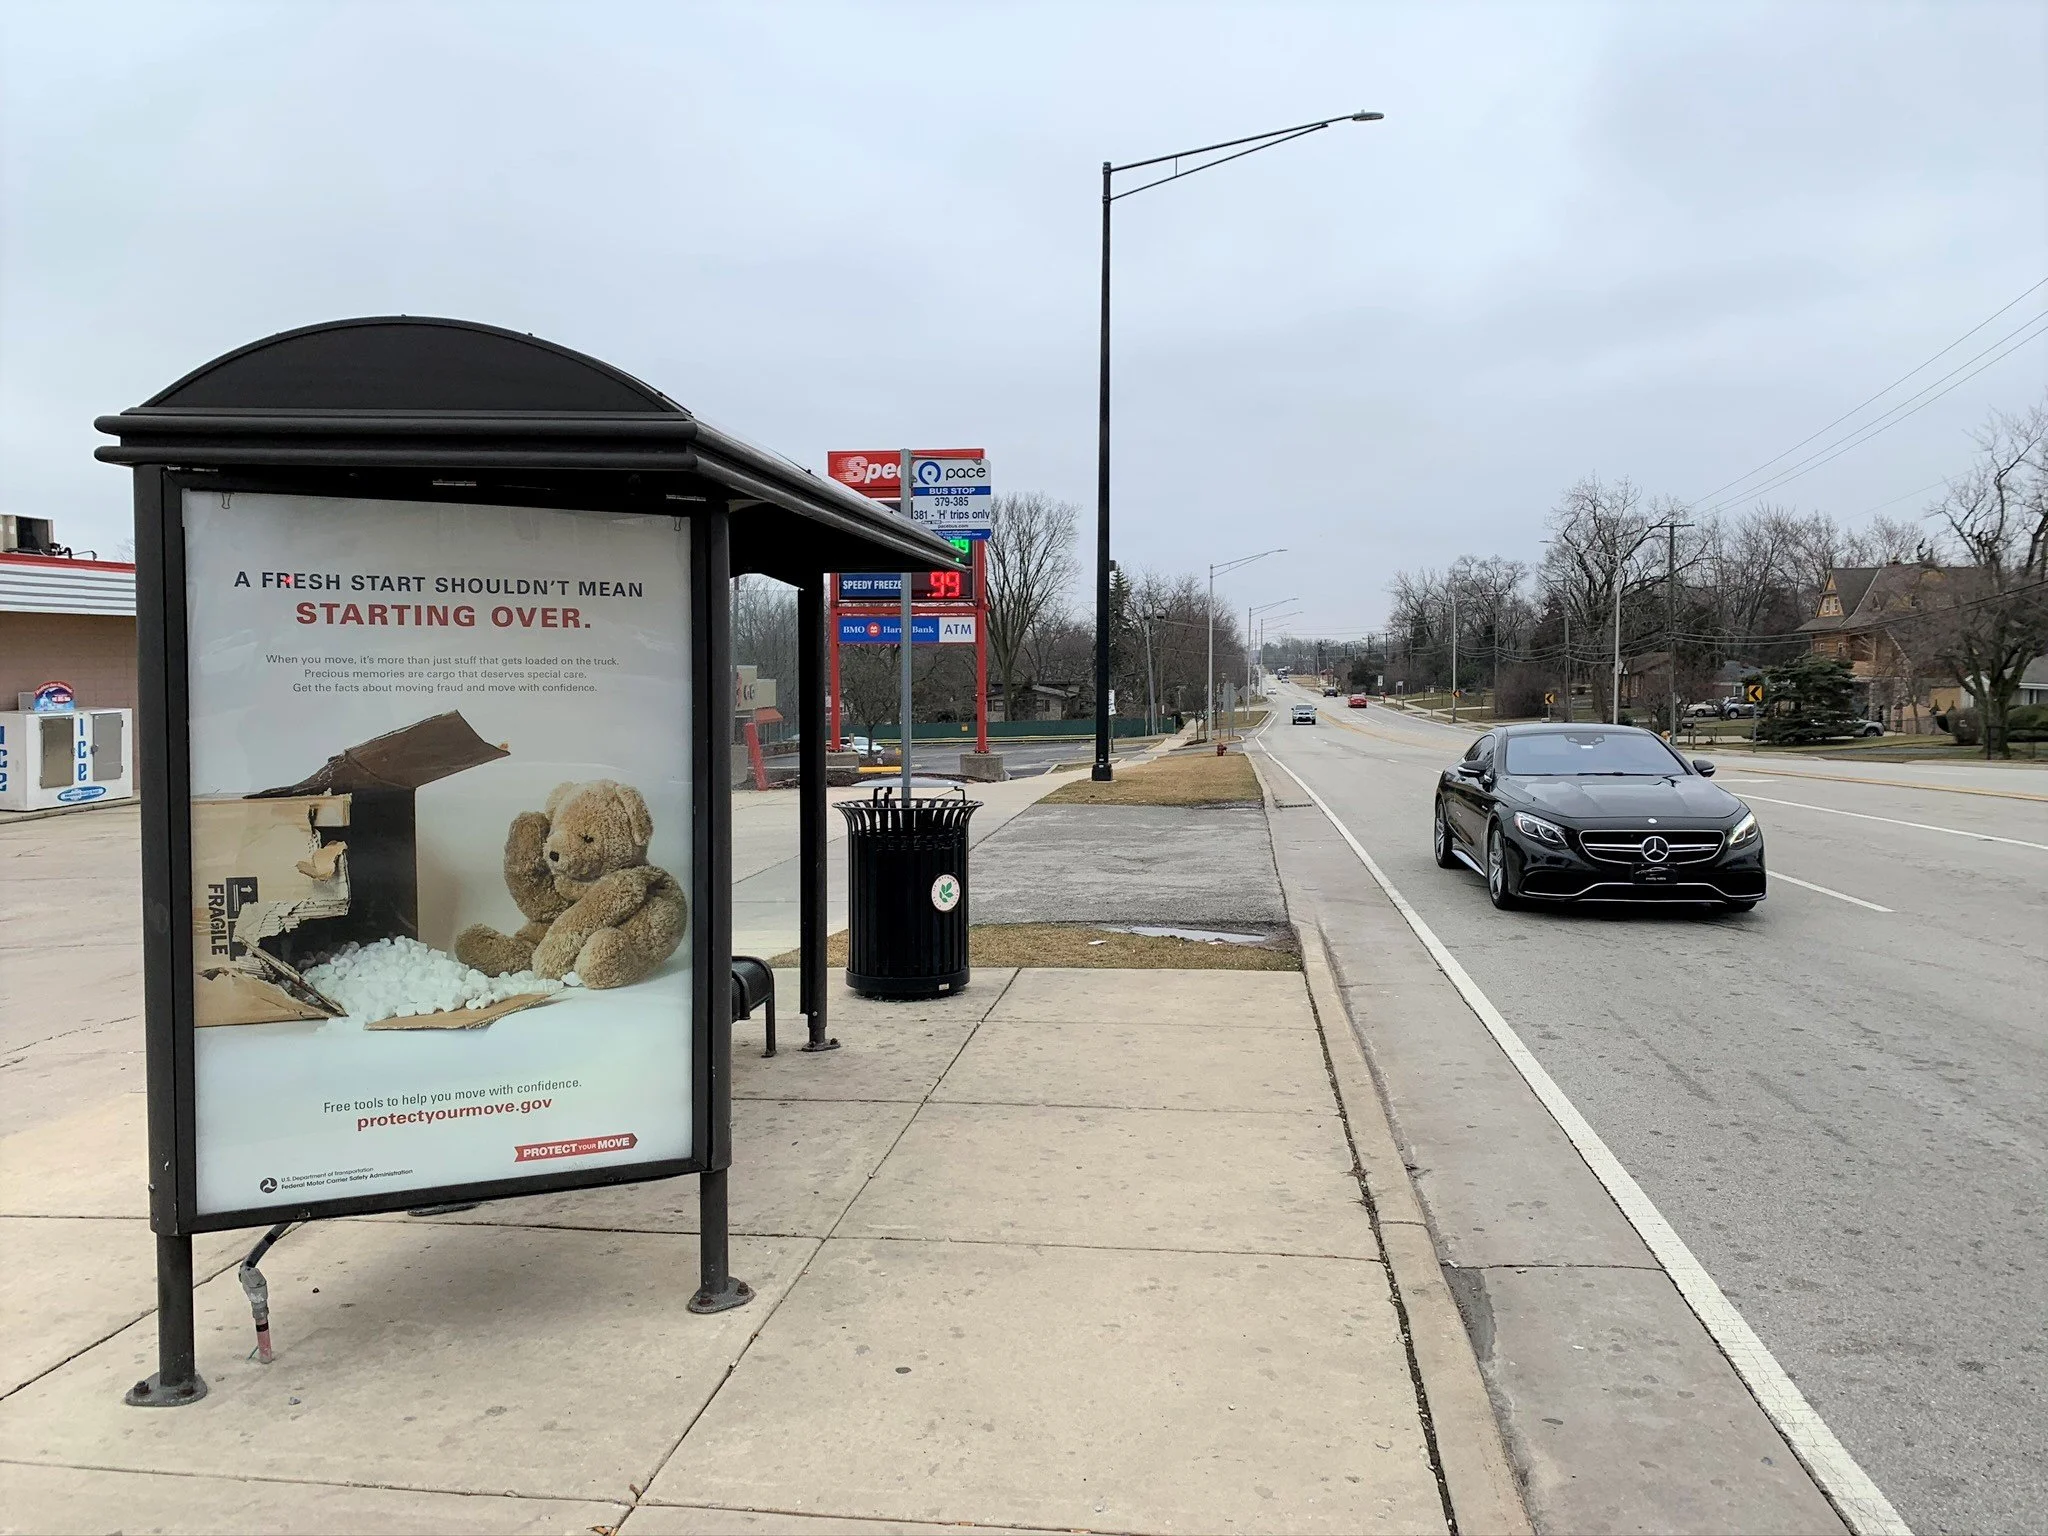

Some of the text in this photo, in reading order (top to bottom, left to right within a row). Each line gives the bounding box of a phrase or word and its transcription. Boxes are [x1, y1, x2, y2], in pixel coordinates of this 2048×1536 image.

[946, 467, 986, 480] pace
[934, 497, 969, 506] 379-385
[914, 510, 928, 520] 381
[950, 510, 970, 520] trips
[972, 509, 990, 520] only
[234, 572, 643, 598] A FRESH START SHOULDN'T MEAN
[842, 580, 872, 590] SPEEDY
[296, 602, 591, 629] STARTING OVER.
[843, 626, 865, 634] BMO
[912, 625, 934, 634] Bank
[944, 624, 972, 635] ATM
[266, 654, 298, 664] When
[301, 656, 320, 666] you
[360, 656, 374, 664] it's
[408, 656, 430, 664] than
[433, 656, 452, 666] just
[454, 656, 476, 664] stuff
[479, 656, 498, 665] that
[502, 657, 522, 666] gets
[525, 656, 558, 665] loaded
[576, 657, 592, 666] the
[594, 657, 620, 666] truck.
[304, 669, 350, 678] Precious
[352, 669, 404, 678] memories
[426, 671, 455, 680] cargo
[458, 670, 478, 678] that
[480, 670, 524, 678] deserves
[528, 670, 560, 680] special
[292, 683, 312, 692] Get
[314, 684, 332, 692] the
[334, 684, 360, 692] facts
[362, 684, 392, 692] about
[396, 684, 434, 694] moving
[436, 683, 464, 692] fraud
[466, 684, 484, 692] and
[518, 684, 540, 692] with
[542, 684, 598, 692] confidence.
[208, 884, 228, 956] FRAGILE
[324, 1079, 582, 1113] Free tools to help you move with confidence.
[358, 1098, 552, 1132] protectyourmove.gov
[523, 1143, 578, 1158] PROTECT
[598, 1137, 630, 1150] MOVE
[282, 1182, 305, 1190] Federal
[370, 1170, 413, 1178] Administration
[292, 1172, 326, 1181] Department
